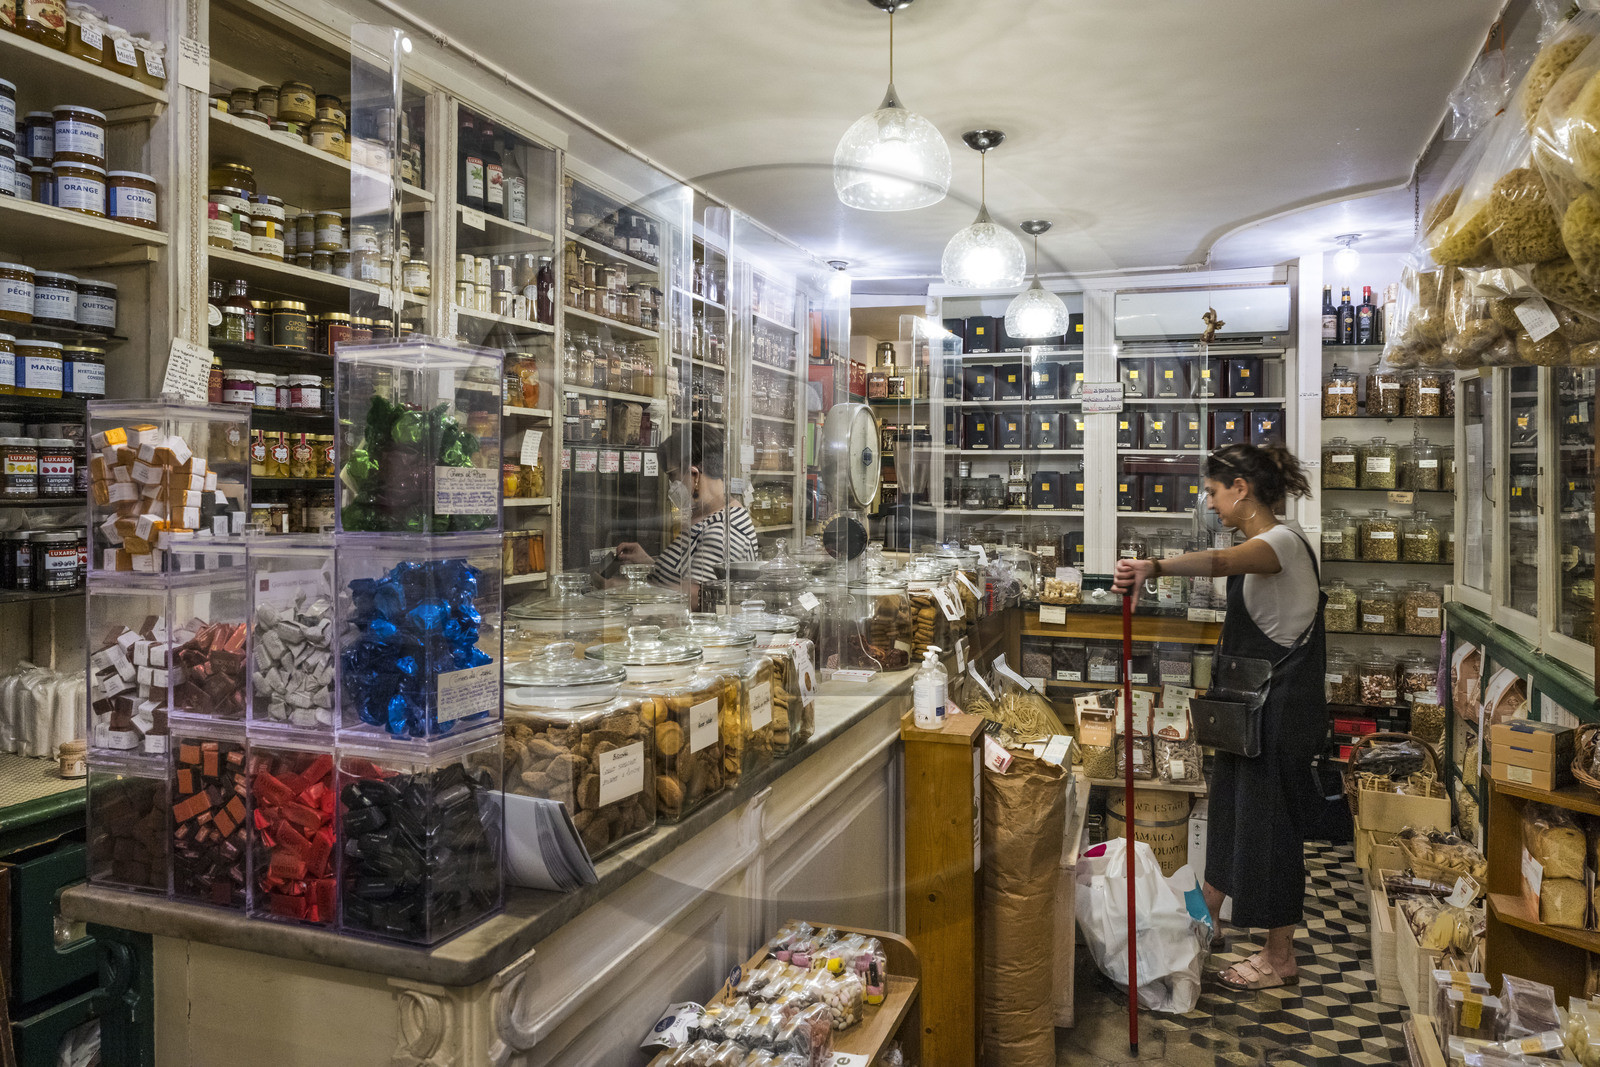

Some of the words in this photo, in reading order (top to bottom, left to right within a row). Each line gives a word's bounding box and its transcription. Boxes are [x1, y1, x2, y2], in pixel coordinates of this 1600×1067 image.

[116, 50, 136, 61] Miele
[80, 130, 99, 139] AMÈRE
[64, 184, 99, 194] ORANGE
[126, 194, 152, 205] COING
[7, 286, 31, 297] PÊCHE
[35, 293, 70, 302] GRIOTTE
[82, 302, 114, 311] QUETSCHE
